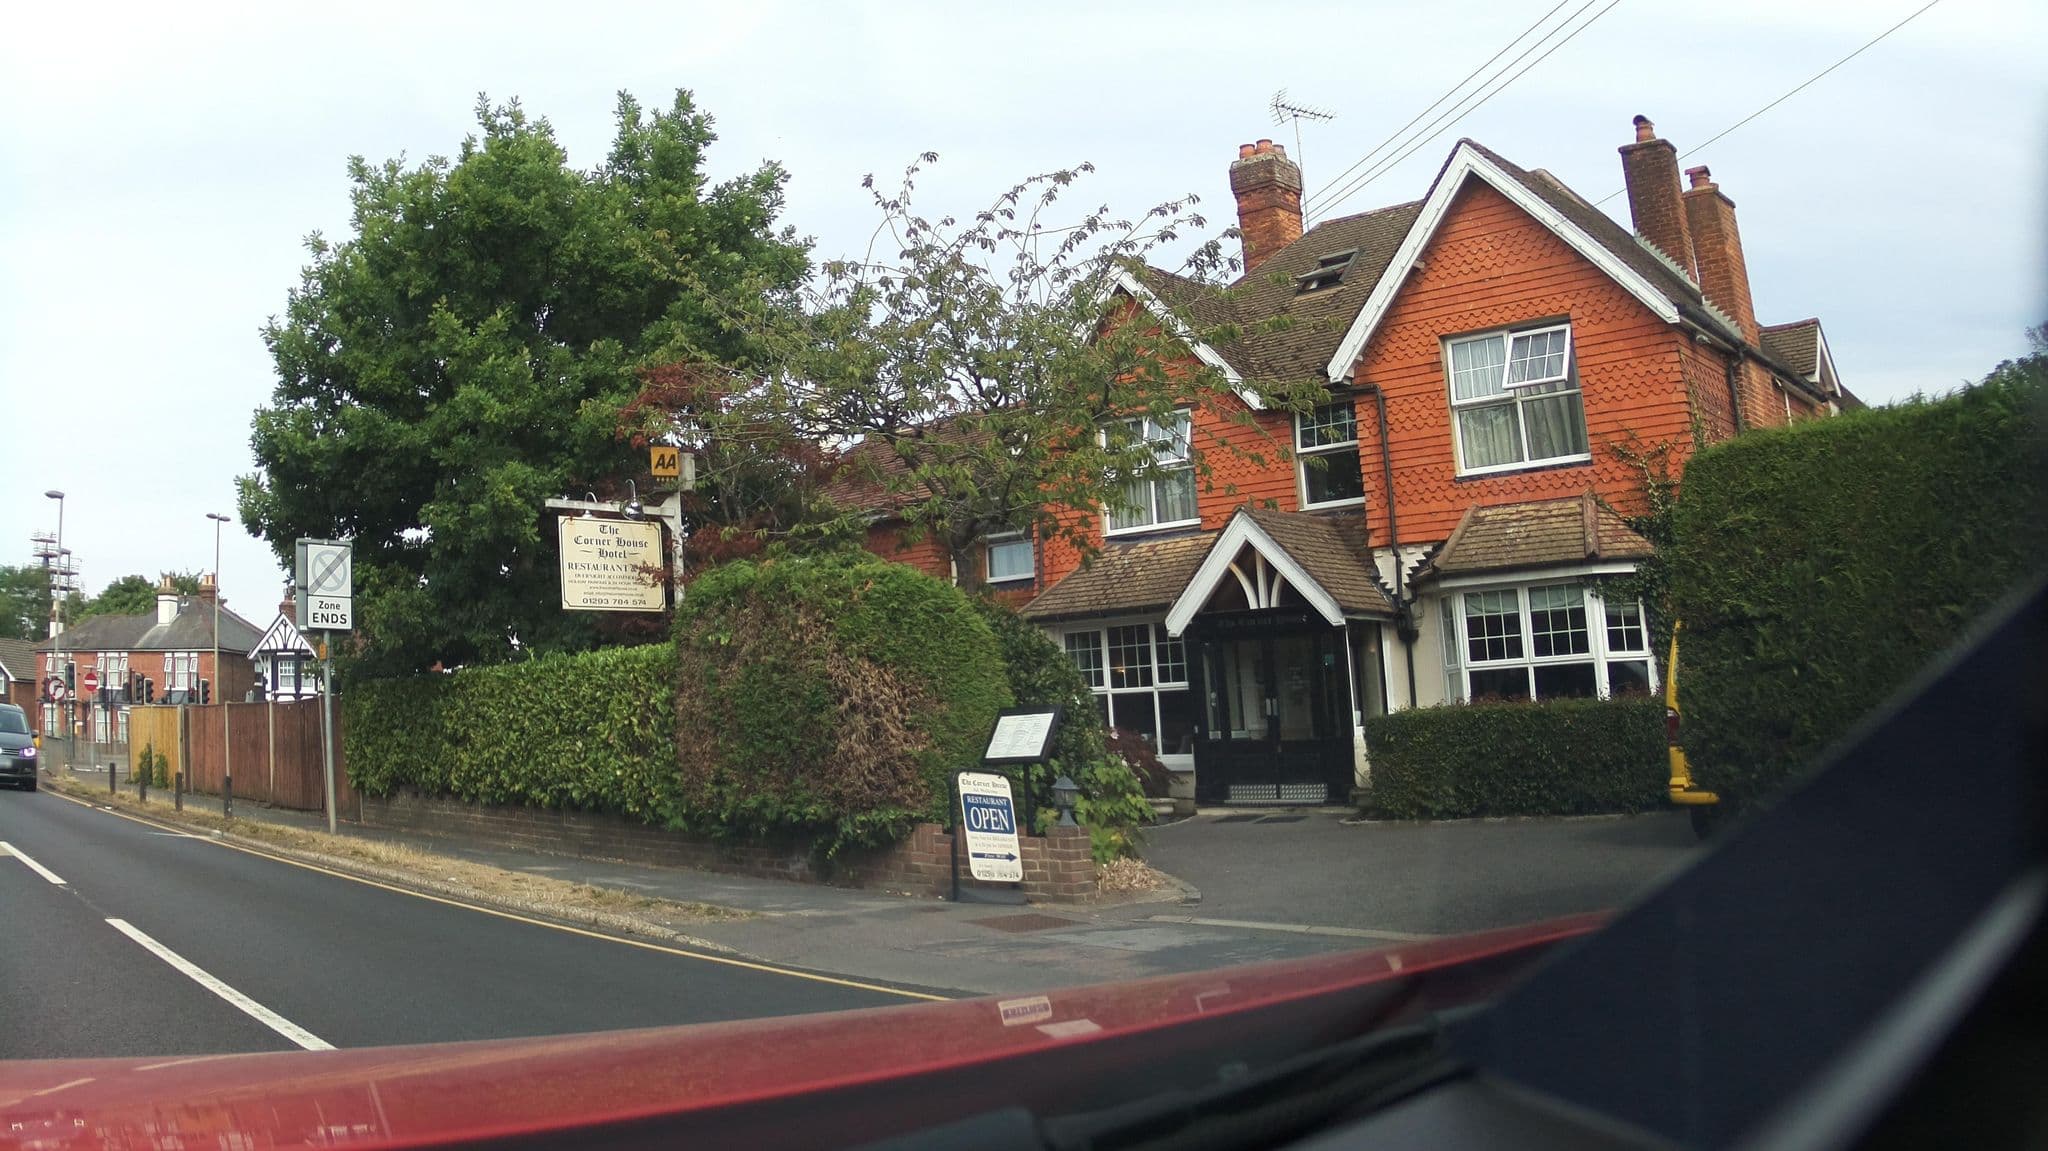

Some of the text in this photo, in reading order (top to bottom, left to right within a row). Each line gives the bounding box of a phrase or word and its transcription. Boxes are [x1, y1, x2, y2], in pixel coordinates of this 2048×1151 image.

[655, 453, 676, 470] AA
[599, 524, 620, 536] The
[573, 535, 649, 548] Corner House
[598, 548, 627, 559] Hotel
[567, 562, 627, 573] RESTAURANT
[318, 600, 341, 610] Zone
[312, 612, 347, 624] ENDS
[966, 796, 1008, 805] RESTAURANT
[970, 806, 1010, 831] OPEN
